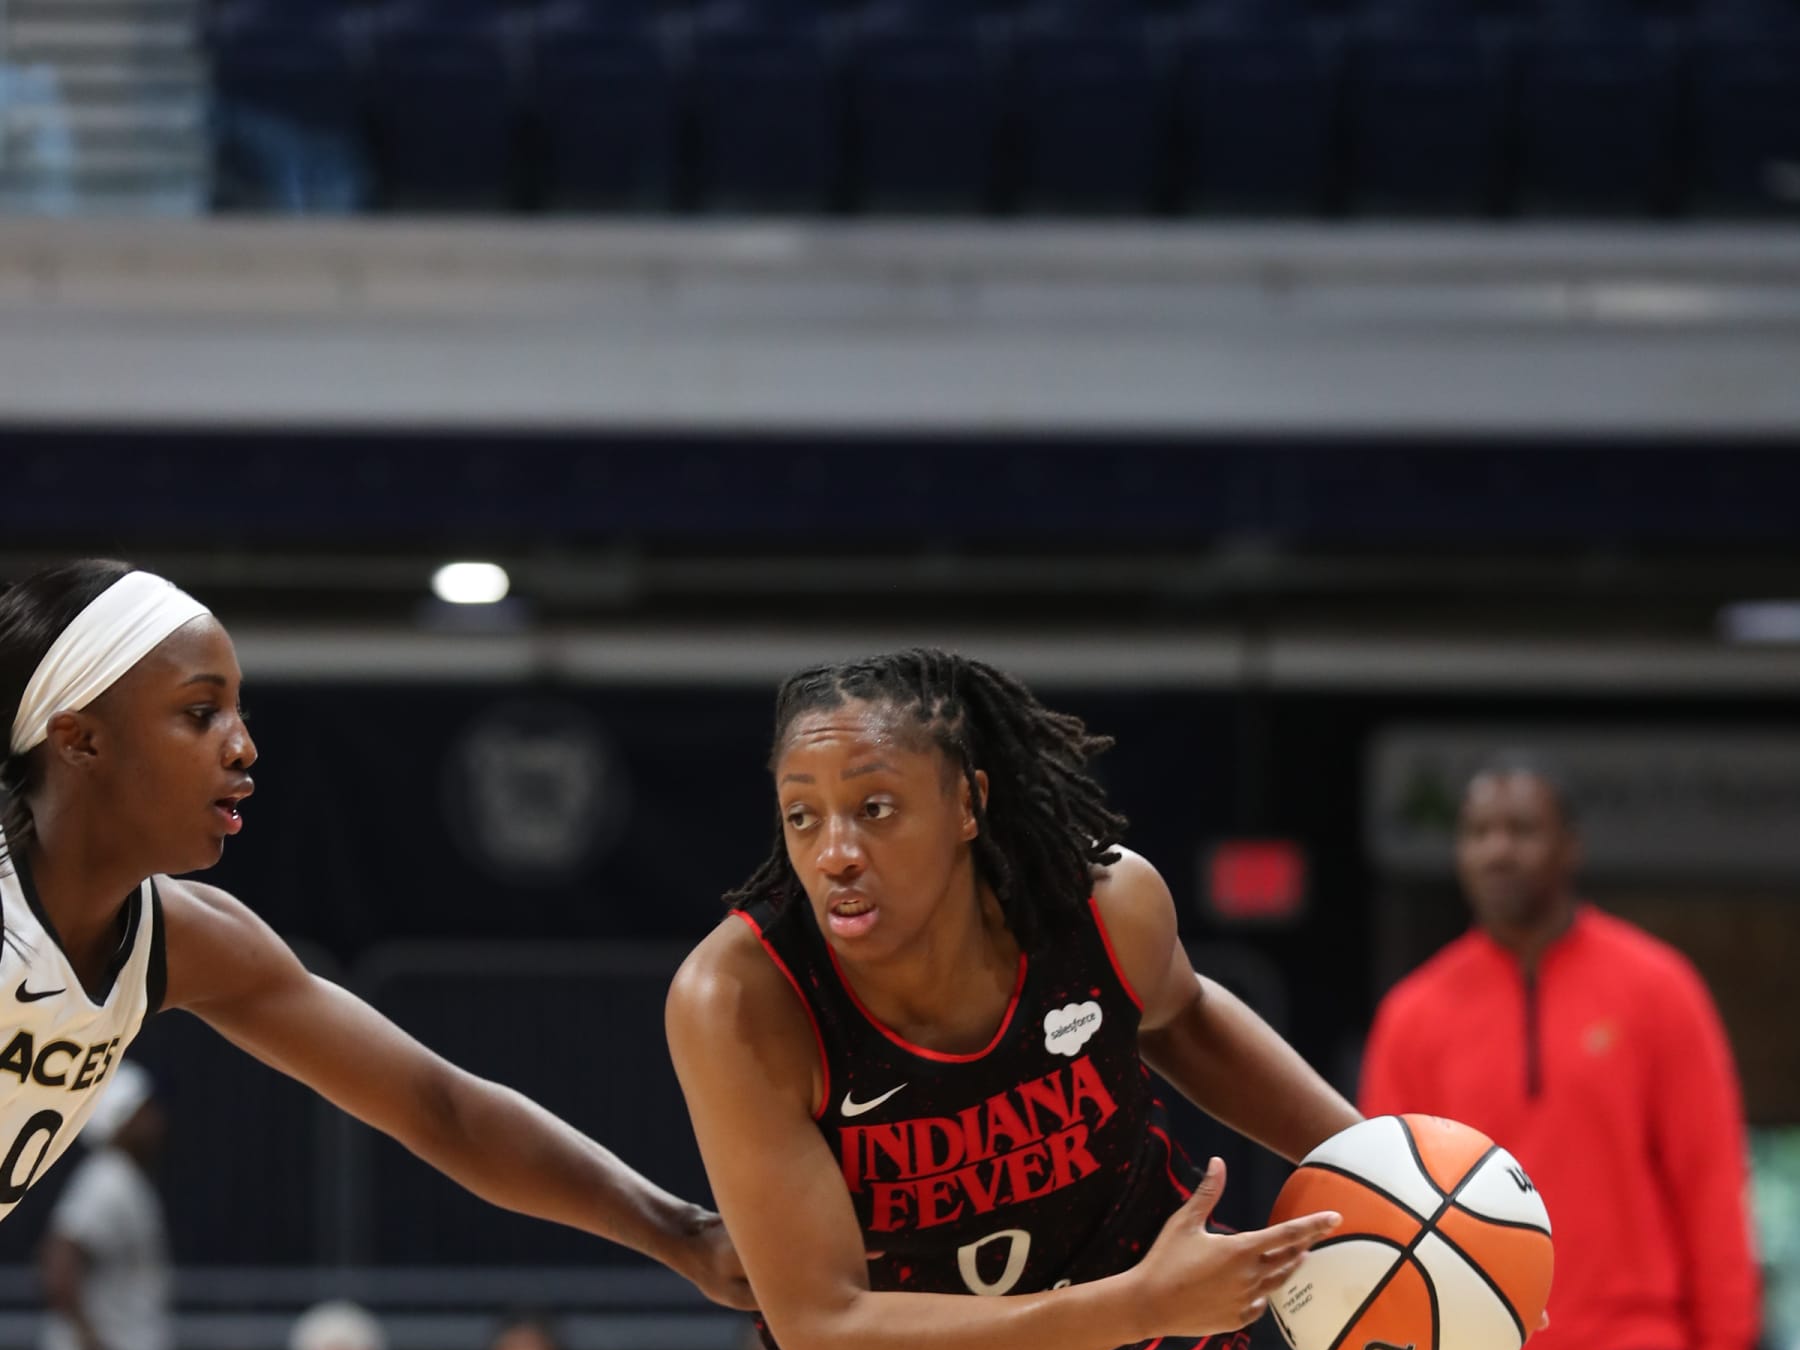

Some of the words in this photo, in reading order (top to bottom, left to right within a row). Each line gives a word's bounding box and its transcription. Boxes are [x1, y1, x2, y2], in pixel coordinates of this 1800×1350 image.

[1050, 1012, 1097, 1041] salesforce
[838, 1055, 1119, 1193] INDIANA
[868, 1123, 1101, 1232] FEVER
[957, 1228, 1032, 1297] 0
